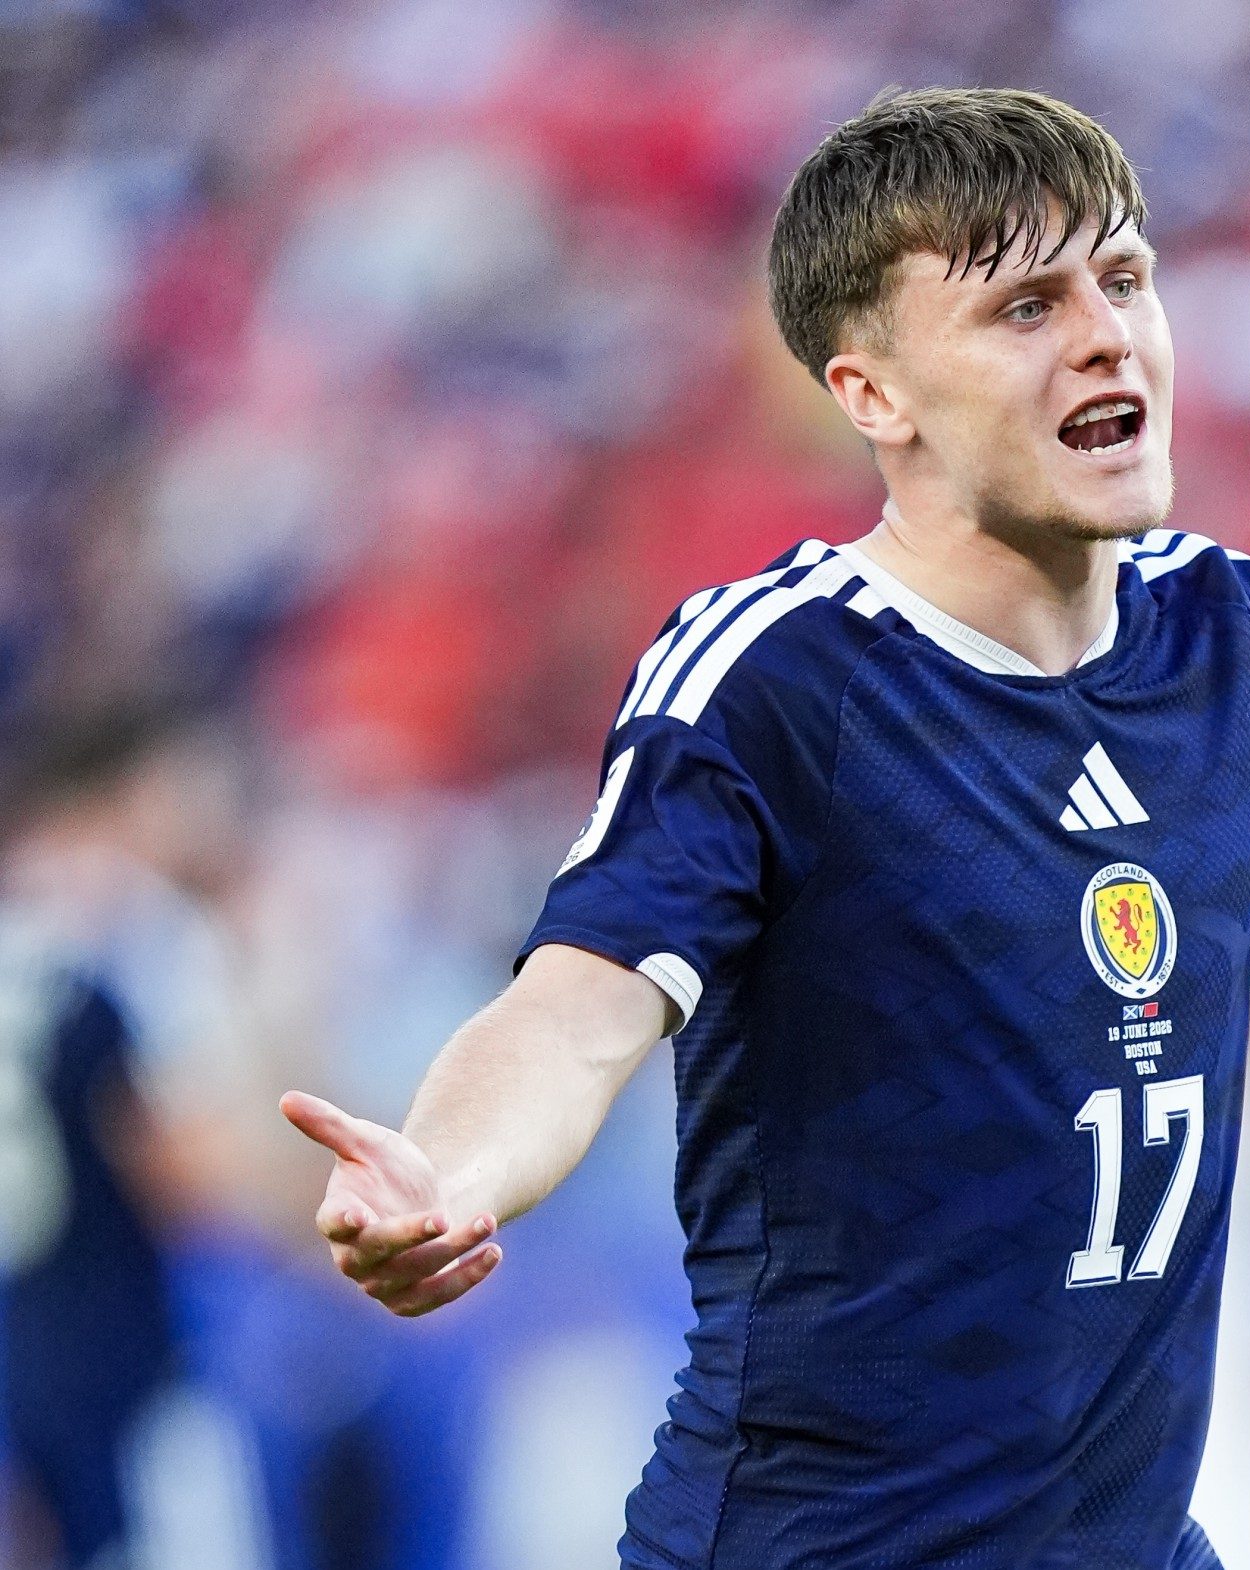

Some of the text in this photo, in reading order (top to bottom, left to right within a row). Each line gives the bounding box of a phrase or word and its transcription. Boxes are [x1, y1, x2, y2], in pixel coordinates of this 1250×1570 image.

[1096, 865, 1144, 886] SCOTLAND
[1104, 962, 1171, 988] EST 1873
[1108, 1019, 1173, 1042] 19 JUNE 2026
[1124, 1040, 1163, 1060] BOSTON
[1135, 1059, 1158, 1076] USA
[1065, 1074, 1205, 1290] 17
